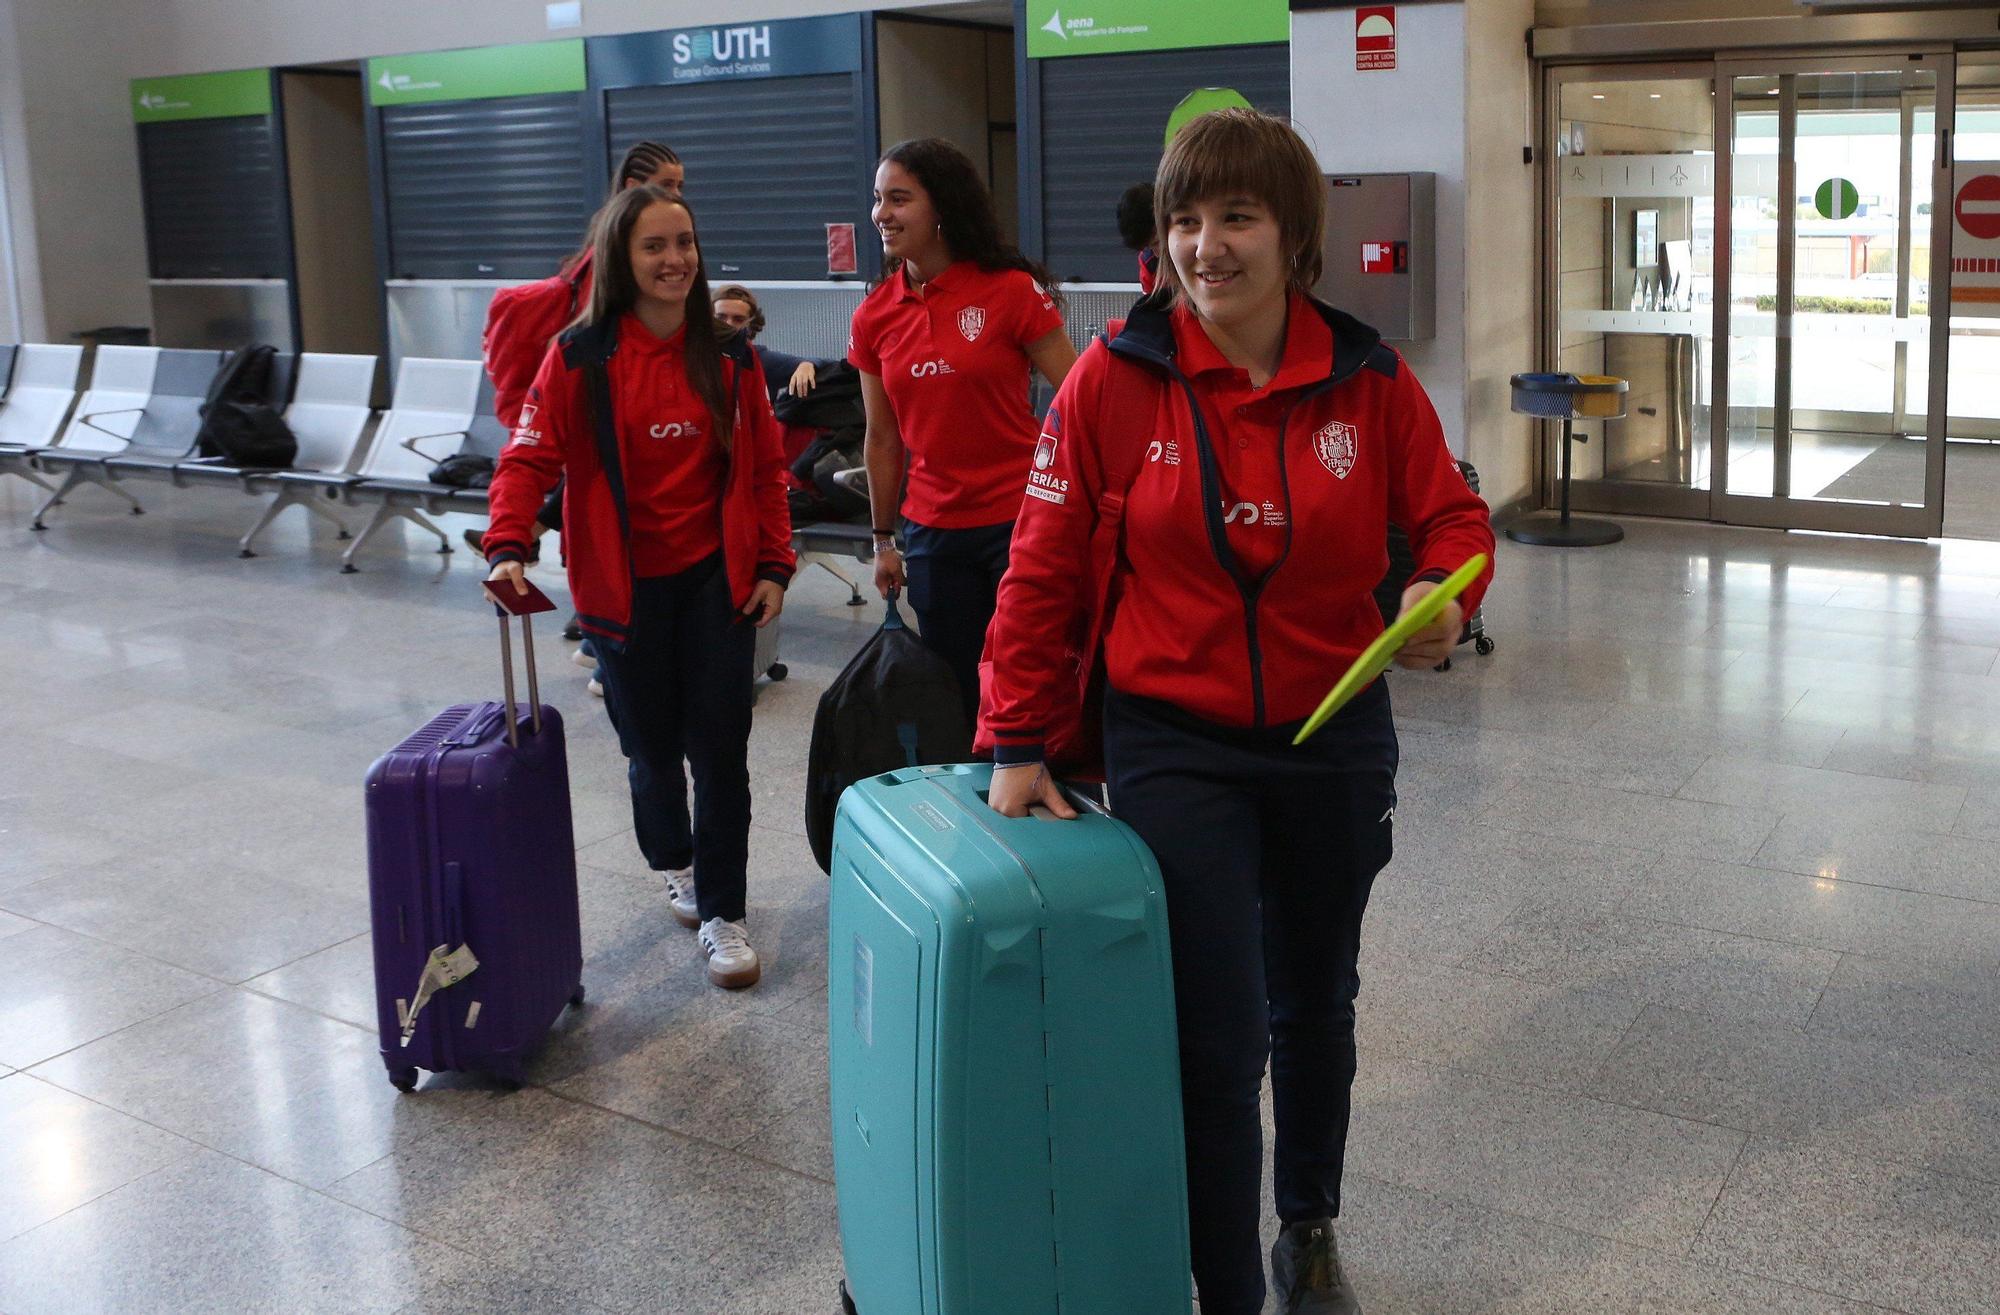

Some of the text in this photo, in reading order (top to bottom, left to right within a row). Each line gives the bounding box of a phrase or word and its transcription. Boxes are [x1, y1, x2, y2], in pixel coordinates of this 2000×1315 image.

[1066, 17, 1094, 29] aena
[673, 62, 771, 79] Europe Ground Services
